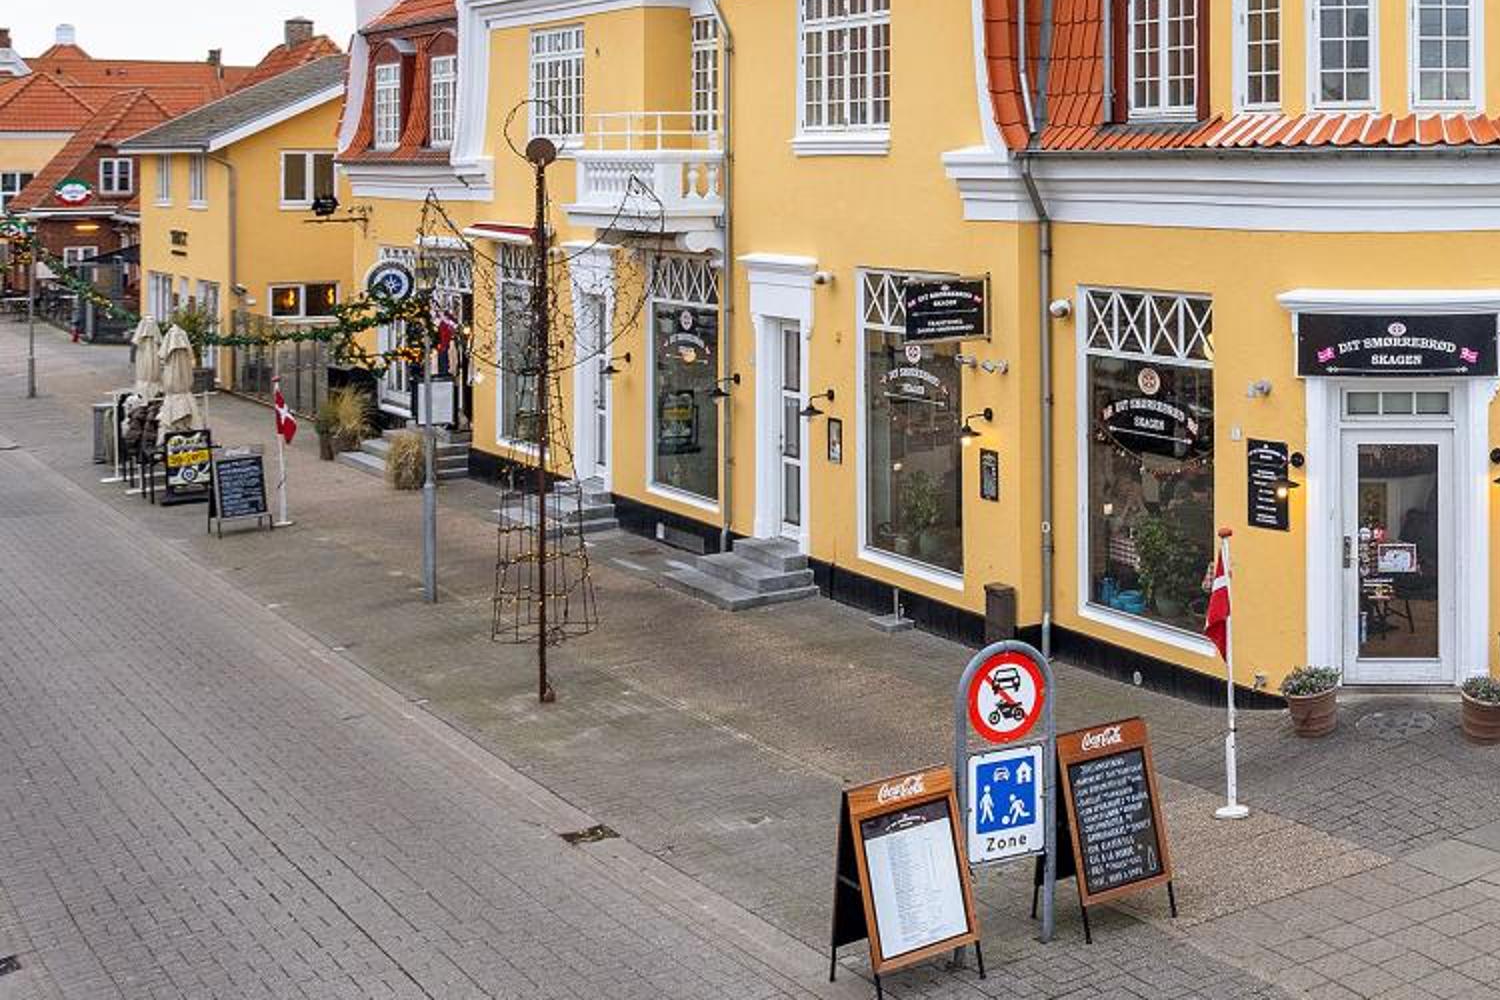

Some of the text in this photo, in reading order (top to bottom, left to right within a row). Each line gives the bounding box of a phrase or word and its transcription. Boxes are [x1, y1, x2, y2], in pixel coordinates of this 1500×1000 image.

[1338, 336, 1457, 354] DIT SMØRREBRØD
[1371, 354, 1423, 365] SKAGEN
[986, 834, 1027, 852] Zone
